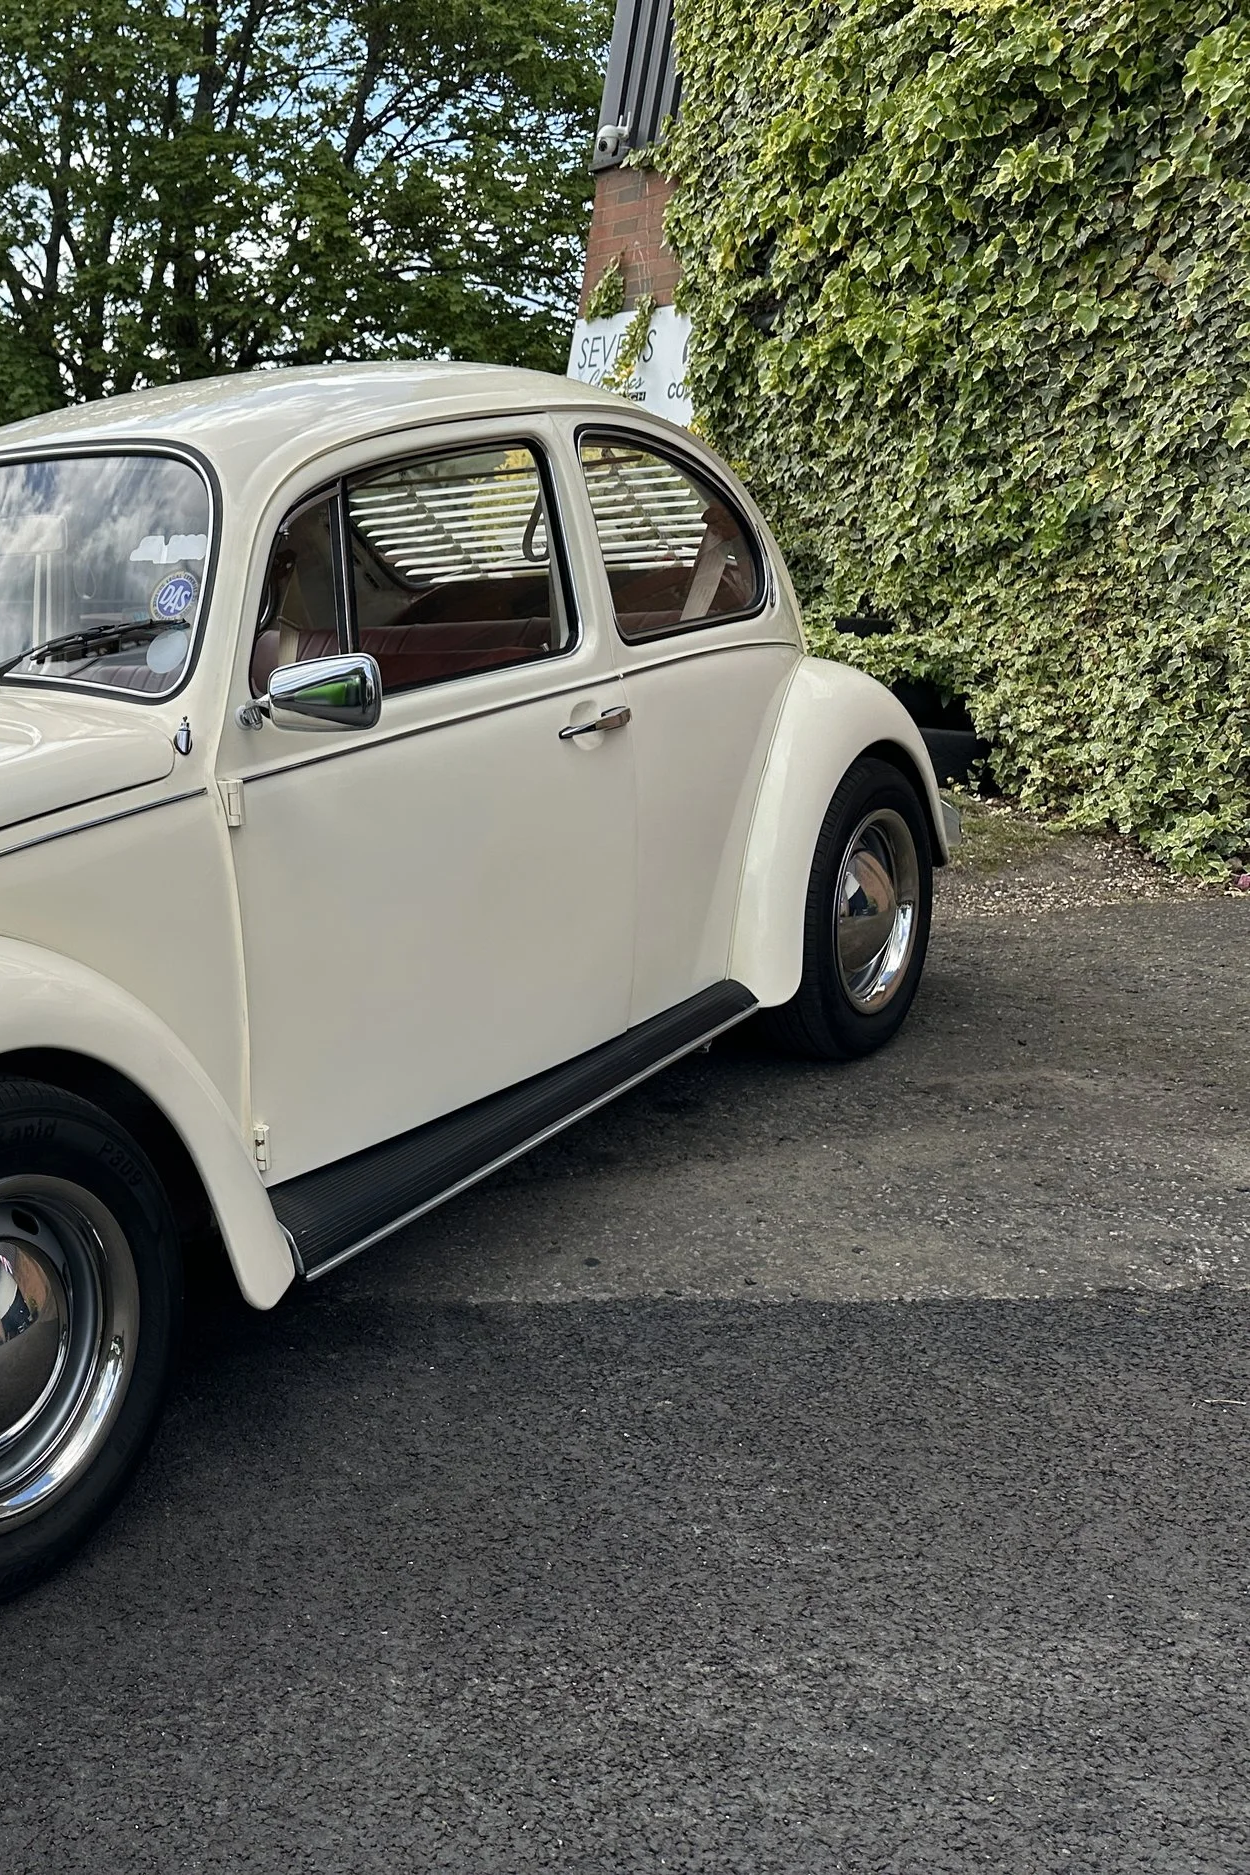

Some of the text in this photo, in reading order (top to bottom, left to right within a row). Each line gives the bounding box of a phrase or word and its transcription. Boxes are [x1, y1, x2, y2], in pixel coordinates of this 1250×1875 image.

[577, 329, 657, 370] SEVES
[158, 584, 191, 613] DAS
[95, 1140, 145, 1186] P309
